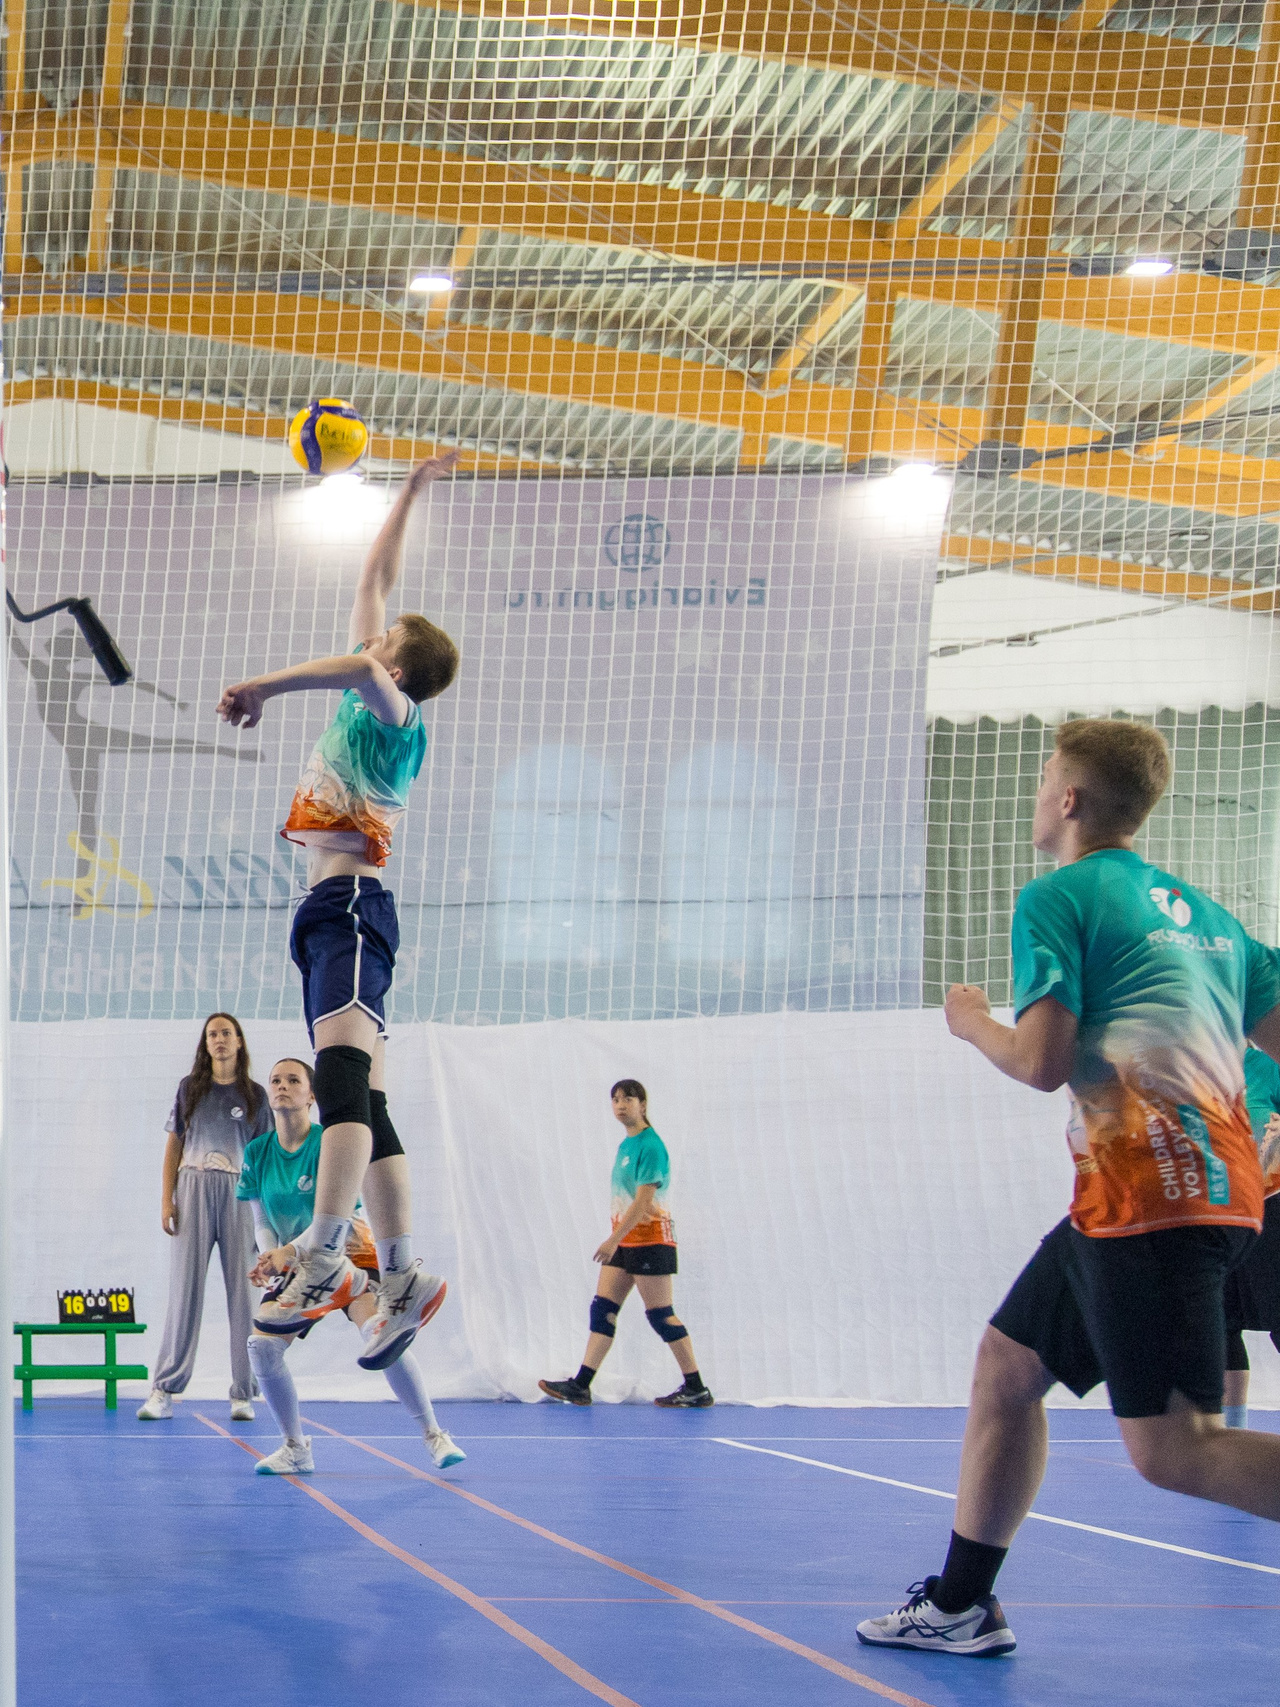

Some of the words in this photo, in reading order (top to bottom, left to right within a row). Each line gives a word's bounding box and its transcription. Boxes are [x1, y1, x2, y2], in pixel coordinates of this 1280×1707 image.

[64, 1295, 85, 1314] 16
[86, 1296, 95, 1307] 0
[98, 1295, 107, 1306] 0
[109, 1293, 130, 1312] 19
